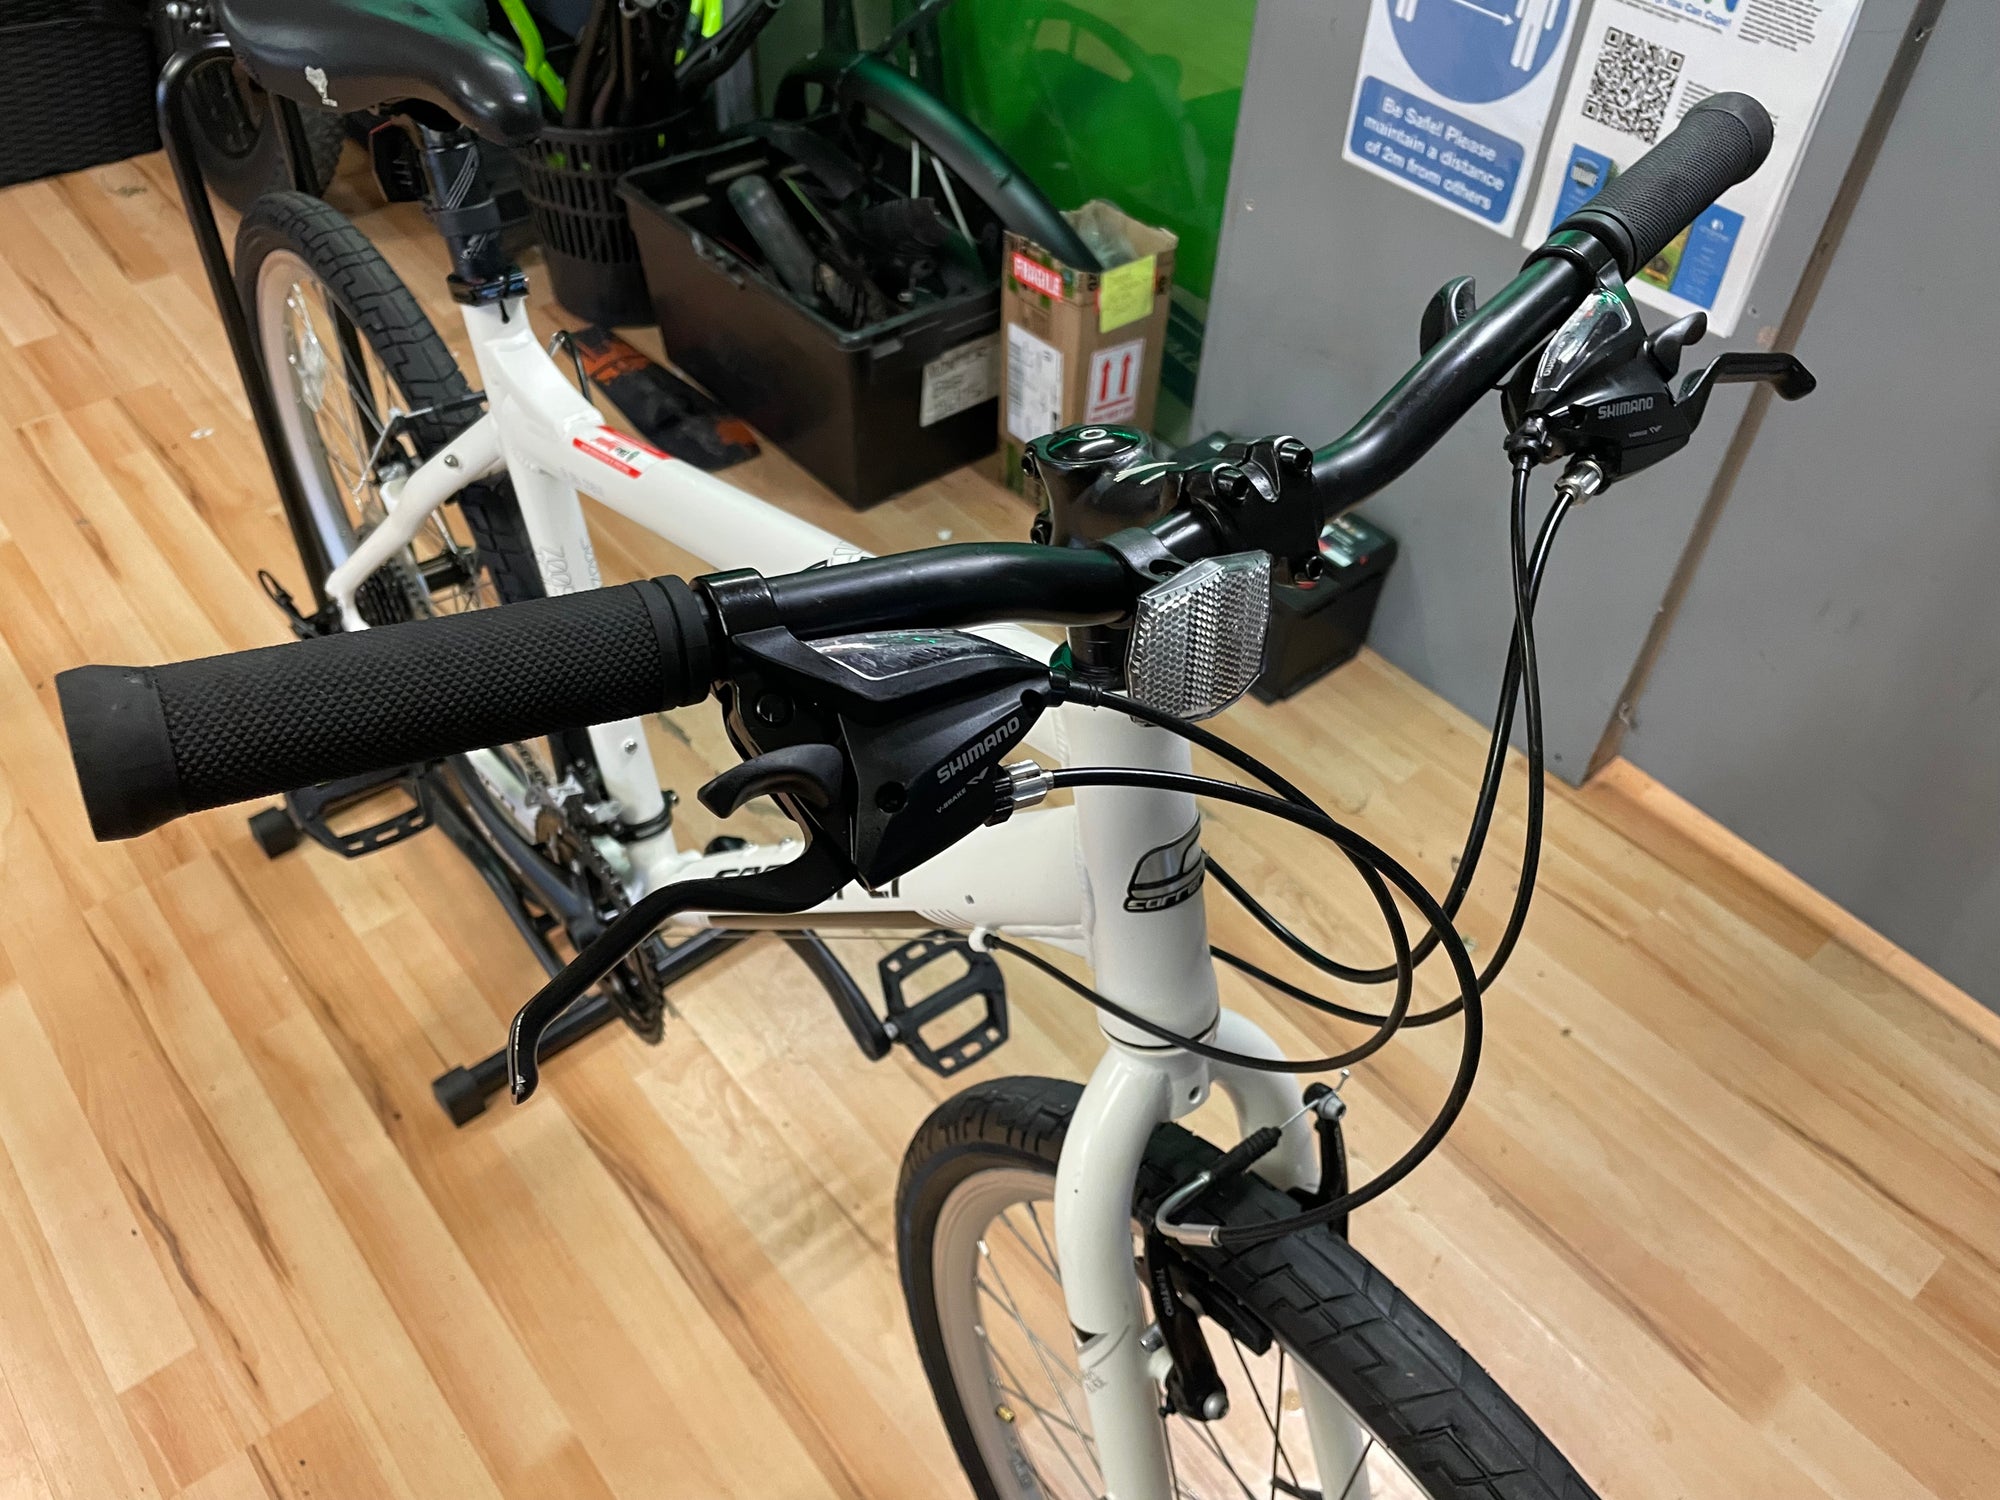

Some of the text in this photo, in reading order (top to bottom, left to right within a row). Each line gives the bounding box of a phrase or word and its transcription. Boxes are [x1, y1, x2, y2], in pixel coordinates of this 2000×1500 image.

[1685, 2, 1702, 16] Can
[1363, 116, 1505, 192] maintain a distance
[1382, 96, 1498, 162] Be Safe! Please
[1364, 140, 1492, 211] of 2m from others
[1597, 396, 1654, 420] SHIMANO
[936, 716, 1021, 785] SHIMANO
[936, 787, 967, 814] V-BRAKE
